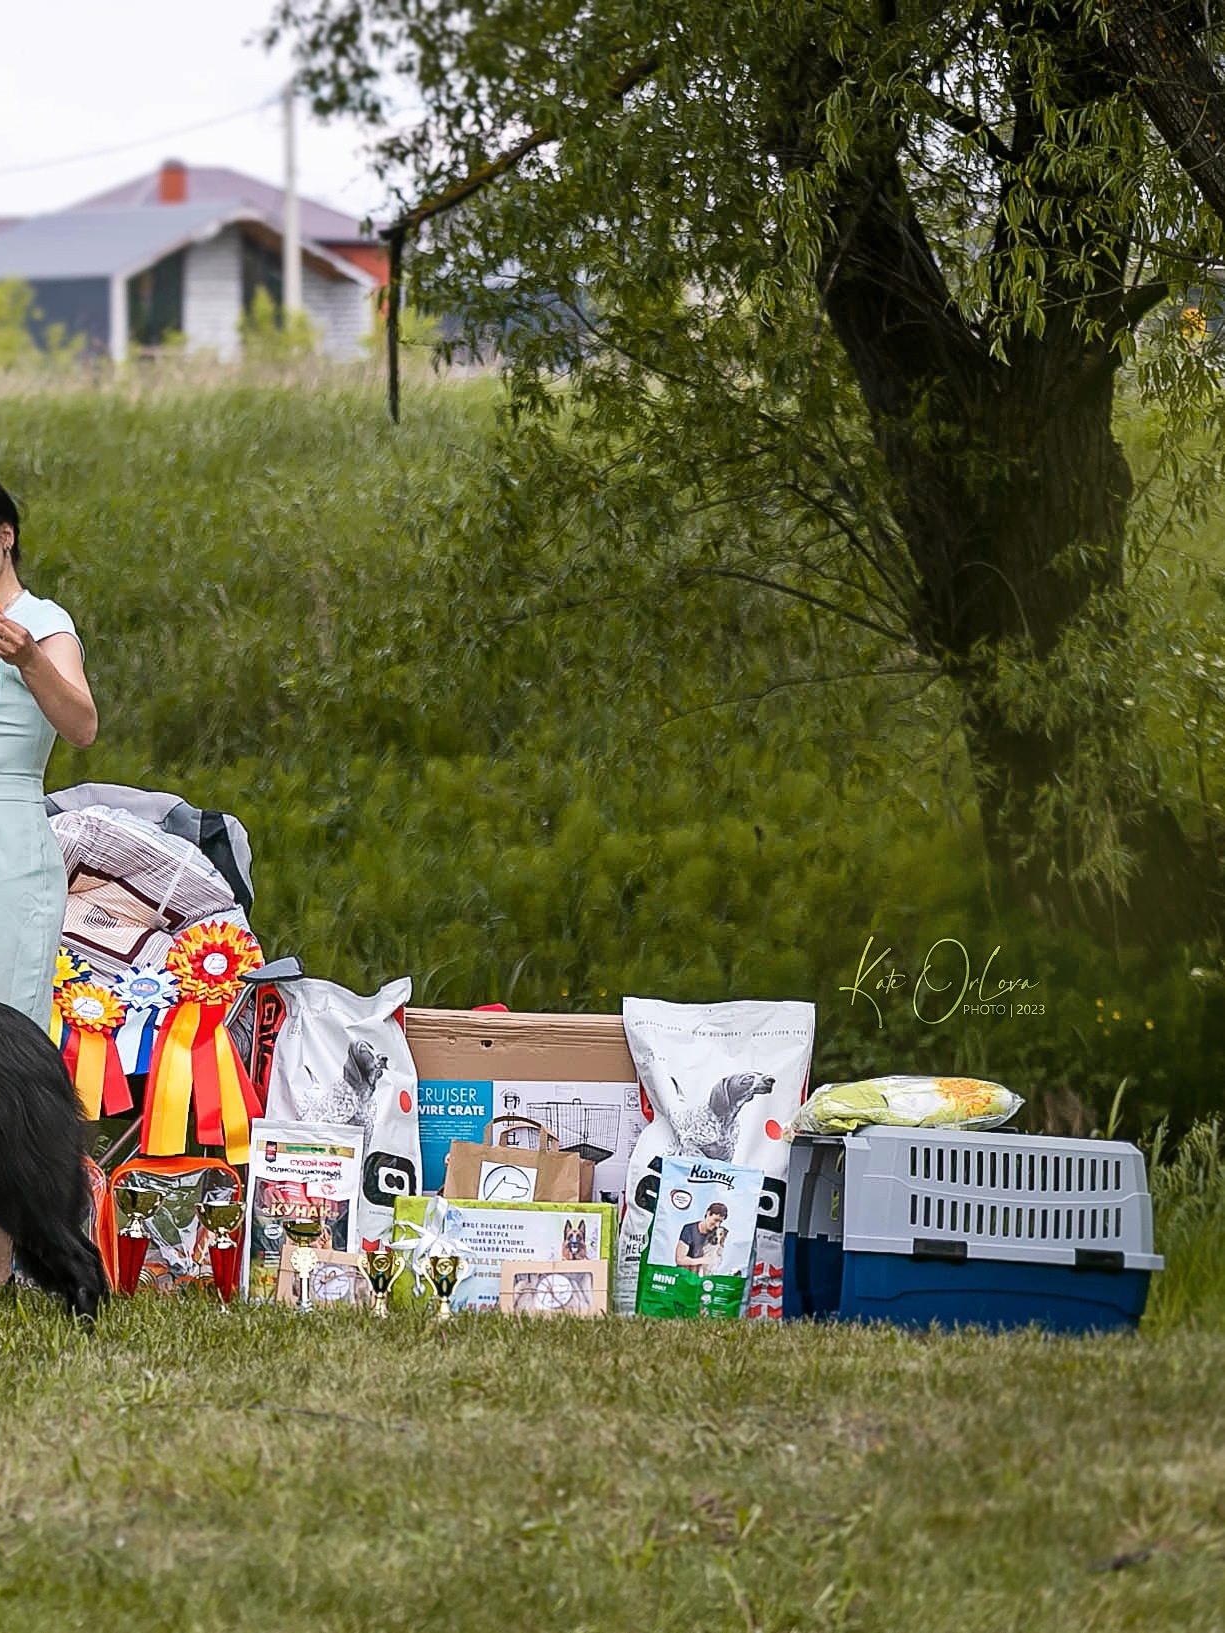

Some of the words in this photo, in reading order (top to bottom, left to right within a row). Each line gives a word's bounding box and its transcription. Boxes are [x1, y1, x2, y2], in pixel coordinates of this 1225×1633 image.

[447, 1105, 485, 1116] CRATE
[290, 1159, 317, 1167] СУХОЙ
[319, 1161, 342, 1169] КОРМ
[689, 1164, 736, 1186] Karmy
[653, 1272, 677, 1286] MINI
